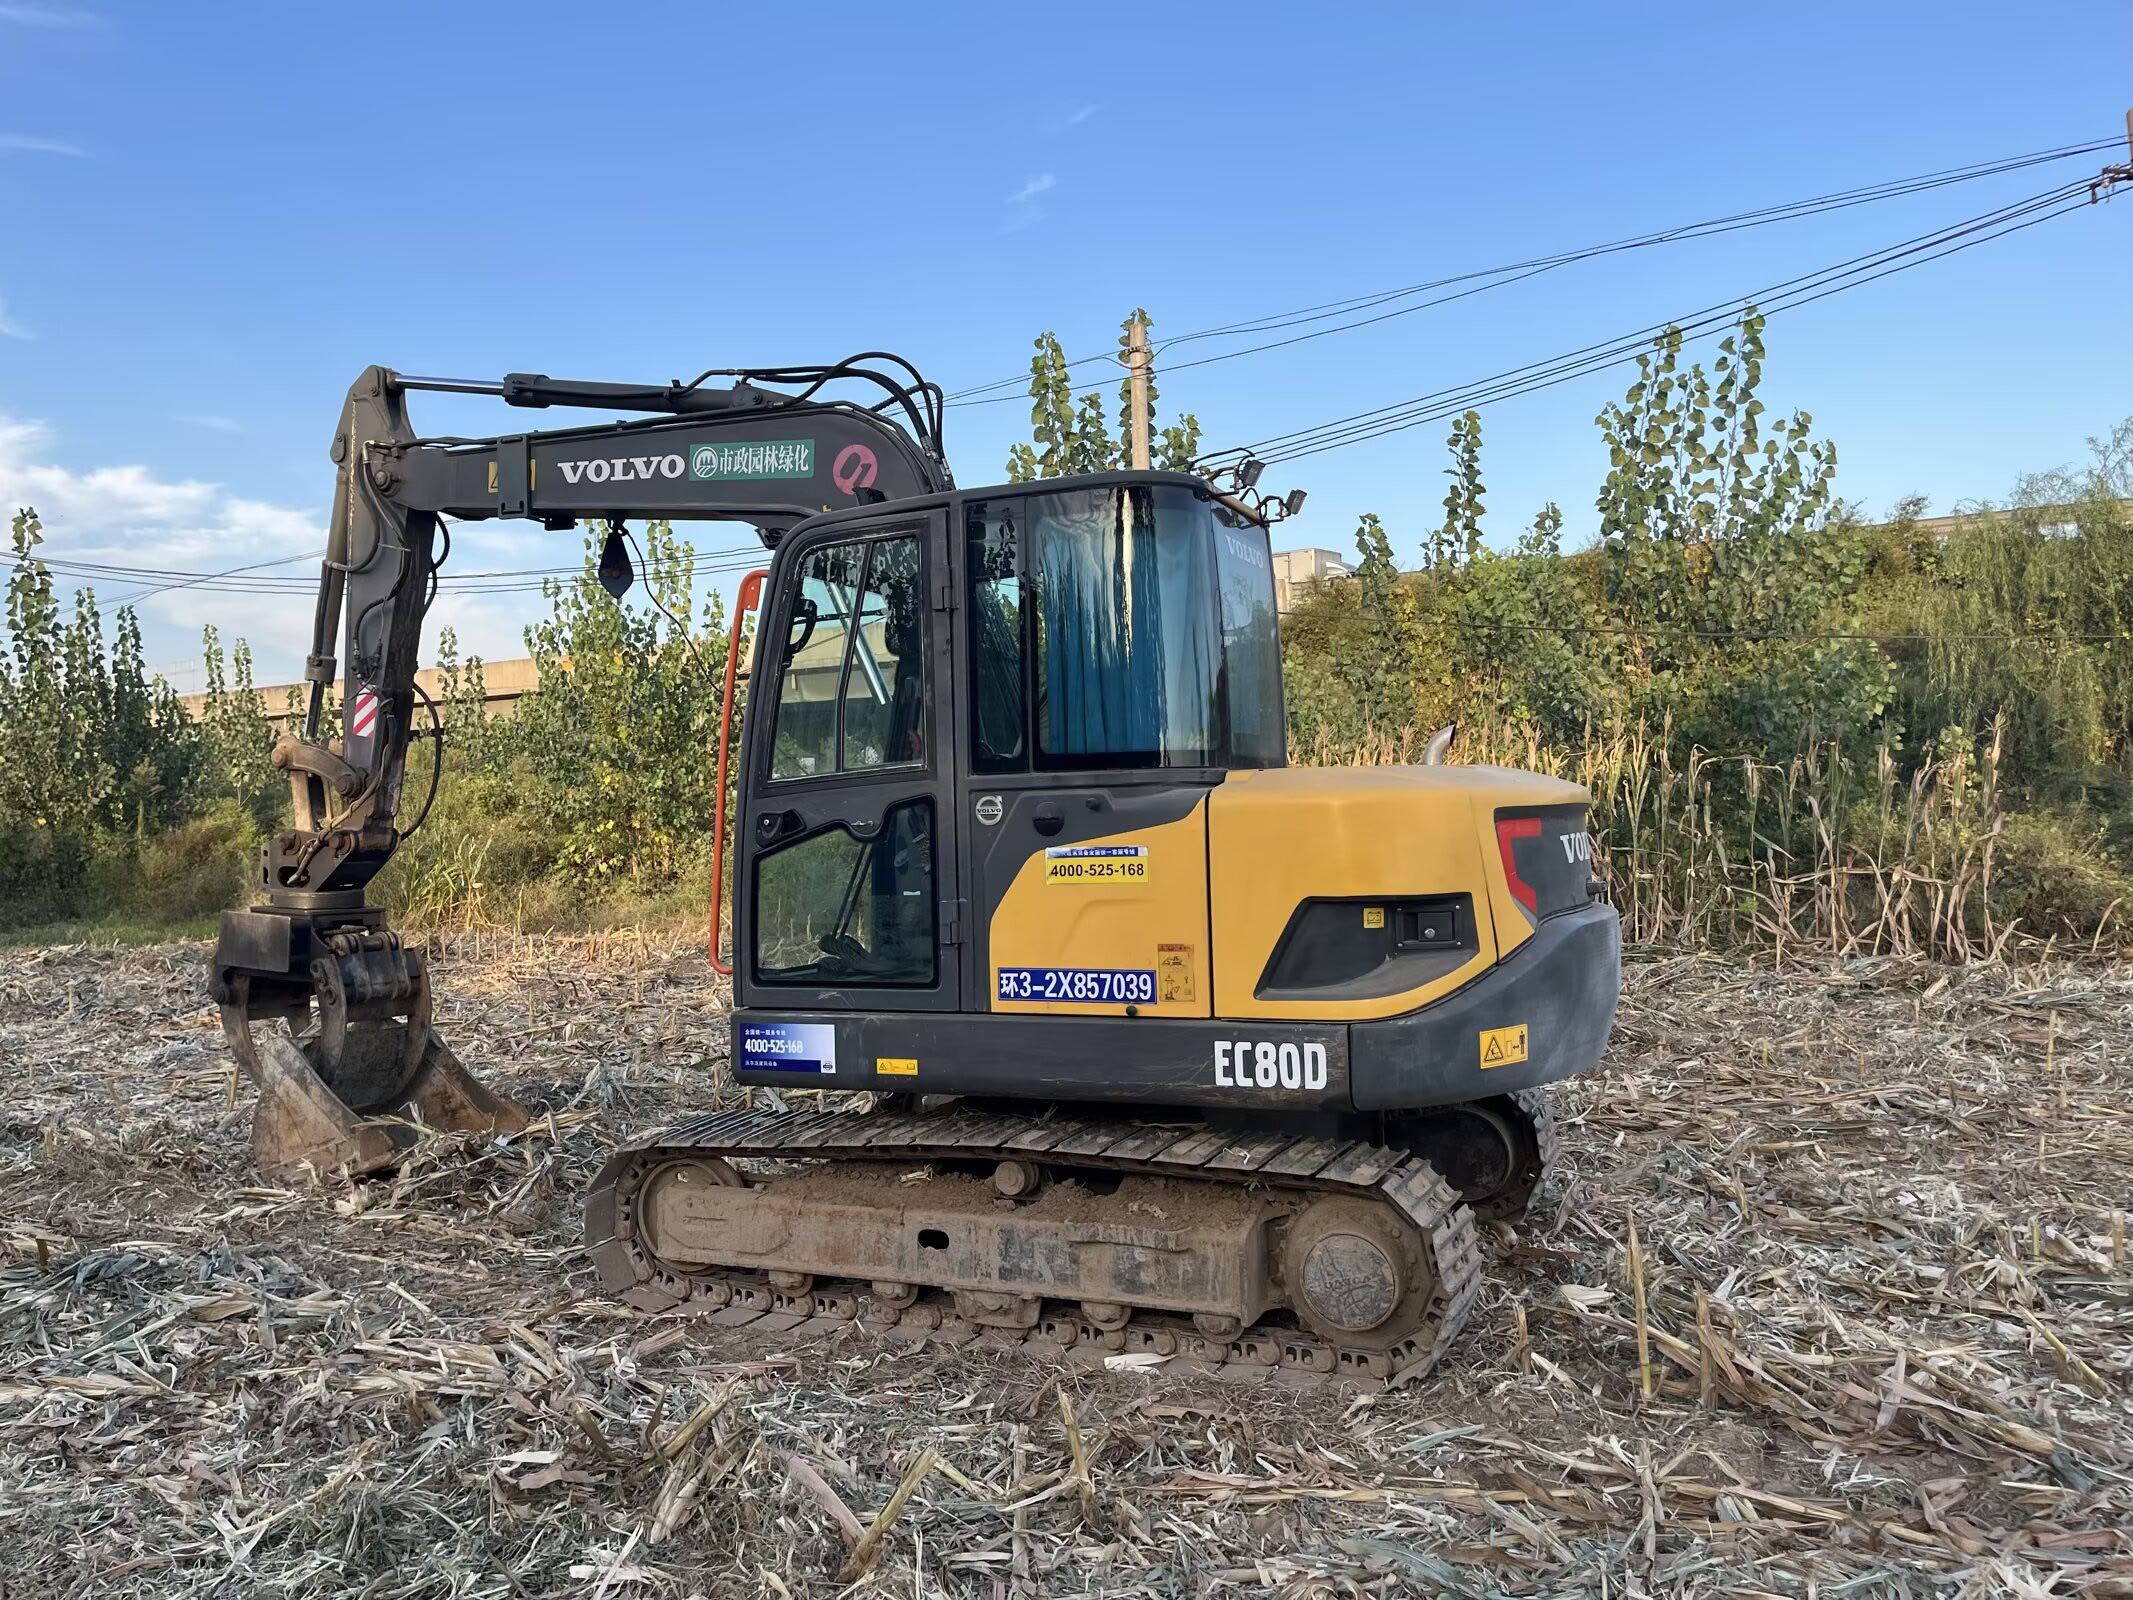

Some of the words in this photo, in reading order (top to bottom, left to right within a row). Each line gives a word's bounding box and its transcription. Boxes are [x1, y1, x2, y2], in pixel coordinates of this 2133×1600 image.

[557, 454, 686, 484] VOLVO
[719, 444, 809, 475] 市政园林绿化
[1226, 535, 1264, 569] VOLVO
[1051, 863, 1144, 877] 4000-525-168
[1000, 971, 1152, 1000] 环3-2X857039
[745, 1039, 804, 1054] 4000-525-168
[1214, 1040, 1328, 1090] EC80D
